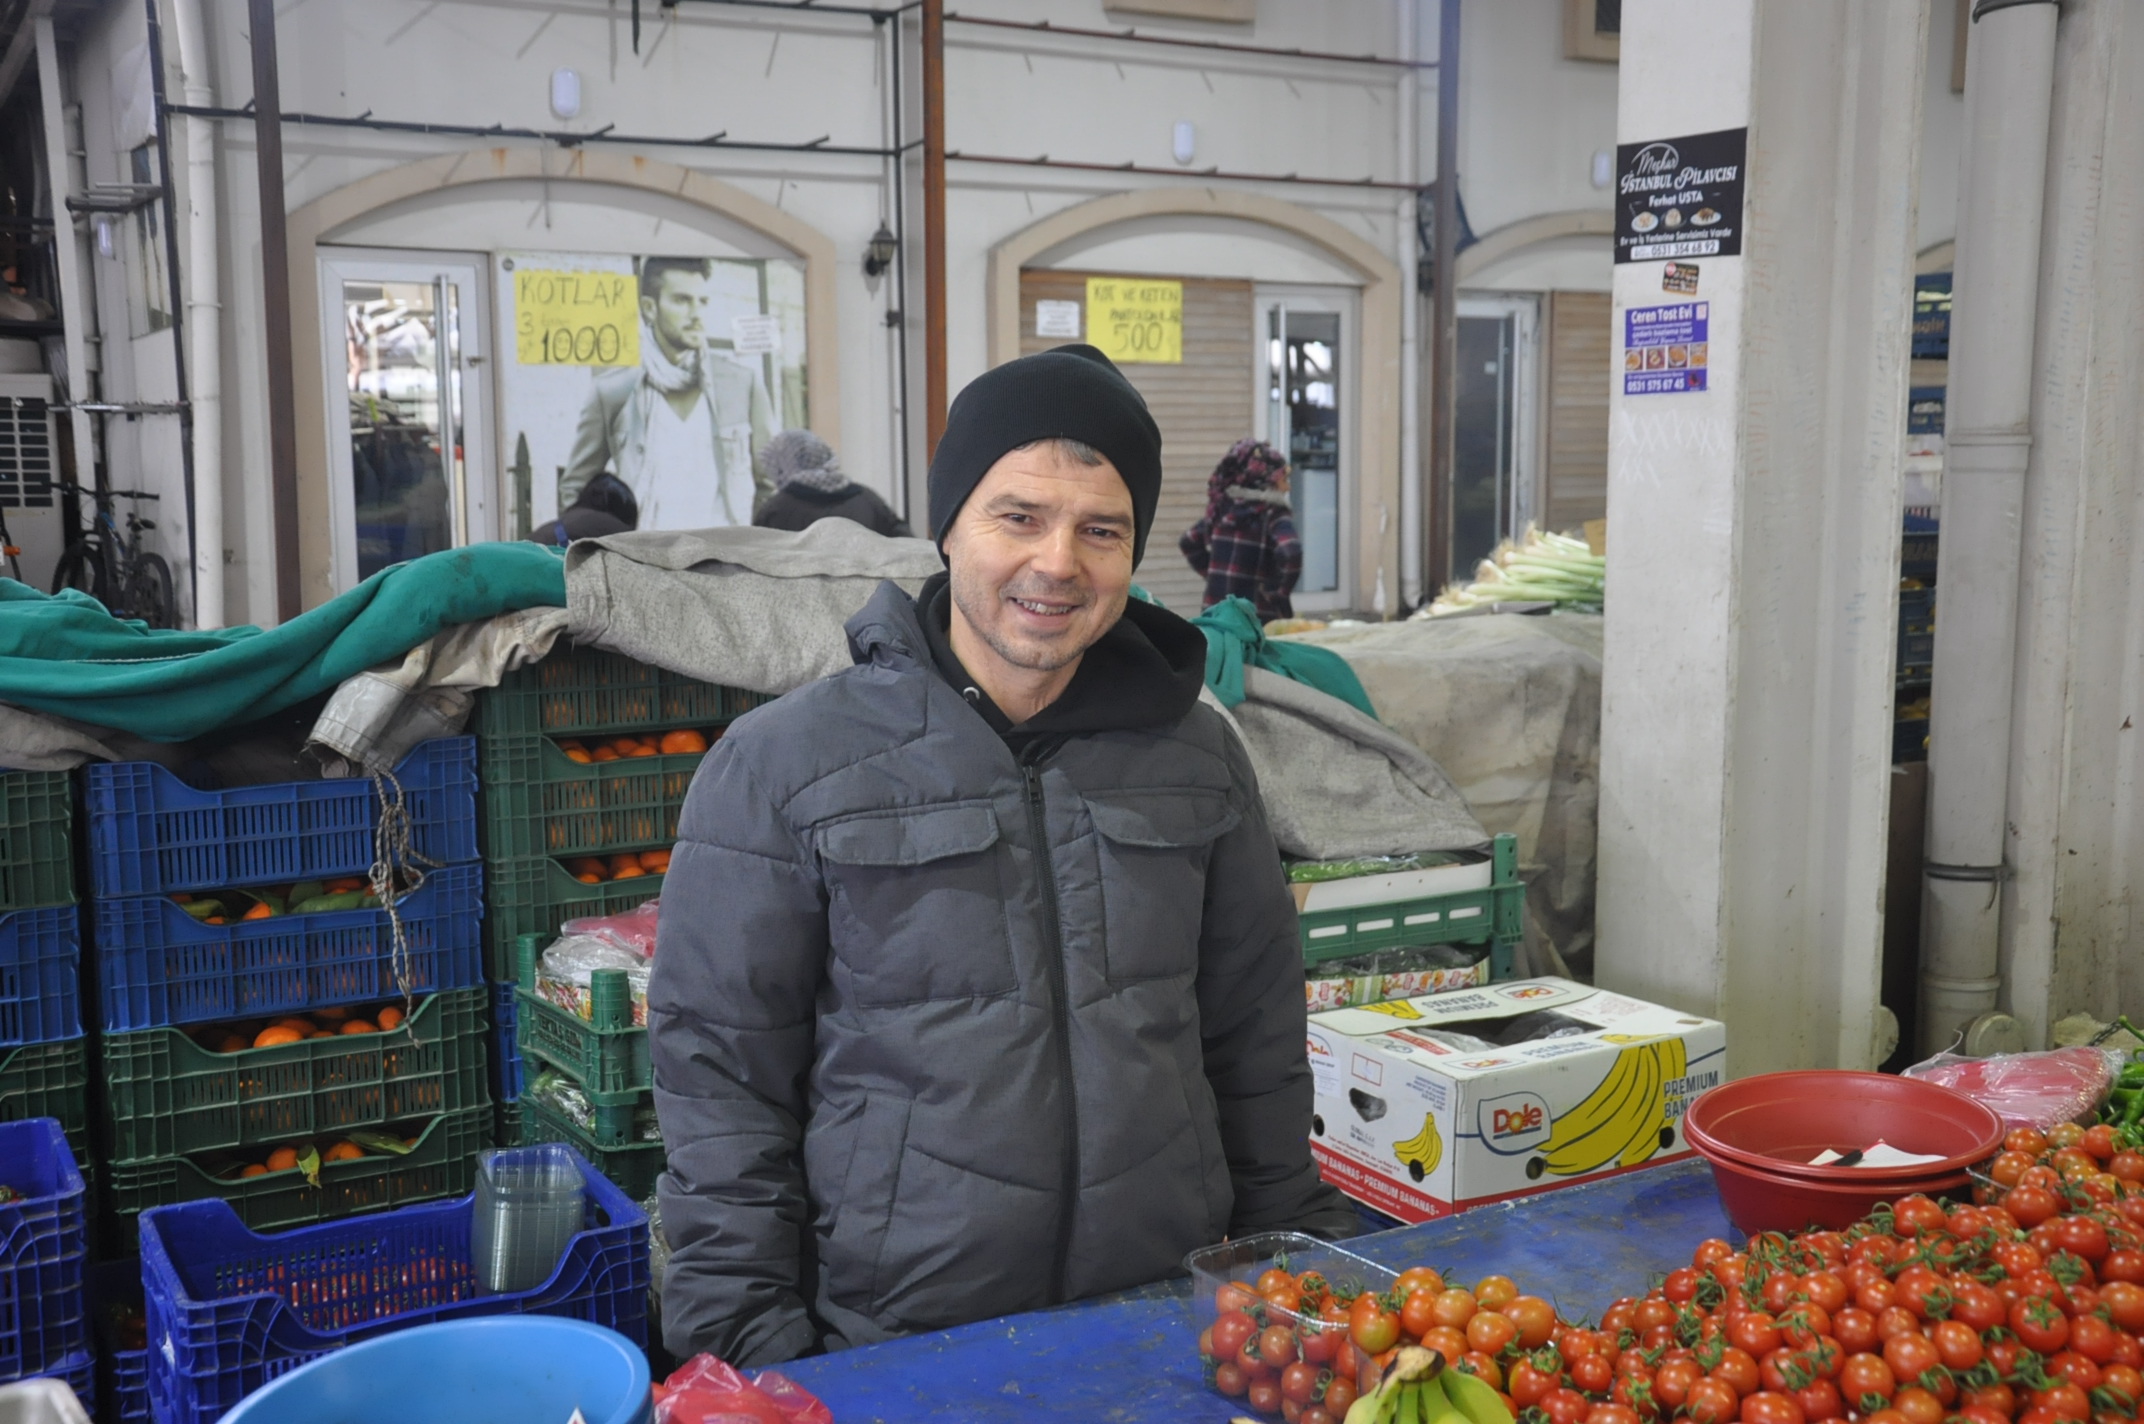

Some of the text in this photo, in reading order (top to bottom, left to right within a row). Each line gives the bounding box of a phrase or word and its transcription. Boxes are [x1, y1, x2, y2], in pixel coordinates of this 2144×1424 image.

[1621, 166, 1738, 194] İSTANBUL PİLAVCISI
[1649, 191, 1703, 207] Ferhat USTA
[1651, 244, 1671, 256] 0531
[1674, 243, 1690, 254] 354
[1705, 241, 1716, 252] 92
[520, 275, 625, 308] KOTLAR
[518, 311, 534, 336] 3
[1631, 310, 1656, 324] Ceren
[1658, 307, 1678, 321] Tost
[541, 323, 620, 364] 1000
[1113, 322, 1163, 353] 500
[1627, 380, 1645, 392] 0531
[1664, 1070, 1718, 1098] PREMIUM
[1493, 1103, 1543, 1134] Dole
[1328, 1157, 1360, 1181] BANANAS
[1364, 1174, 1399, 1199] PREMIUM
[1399, 1191, 1436, 1216] BANANAS
